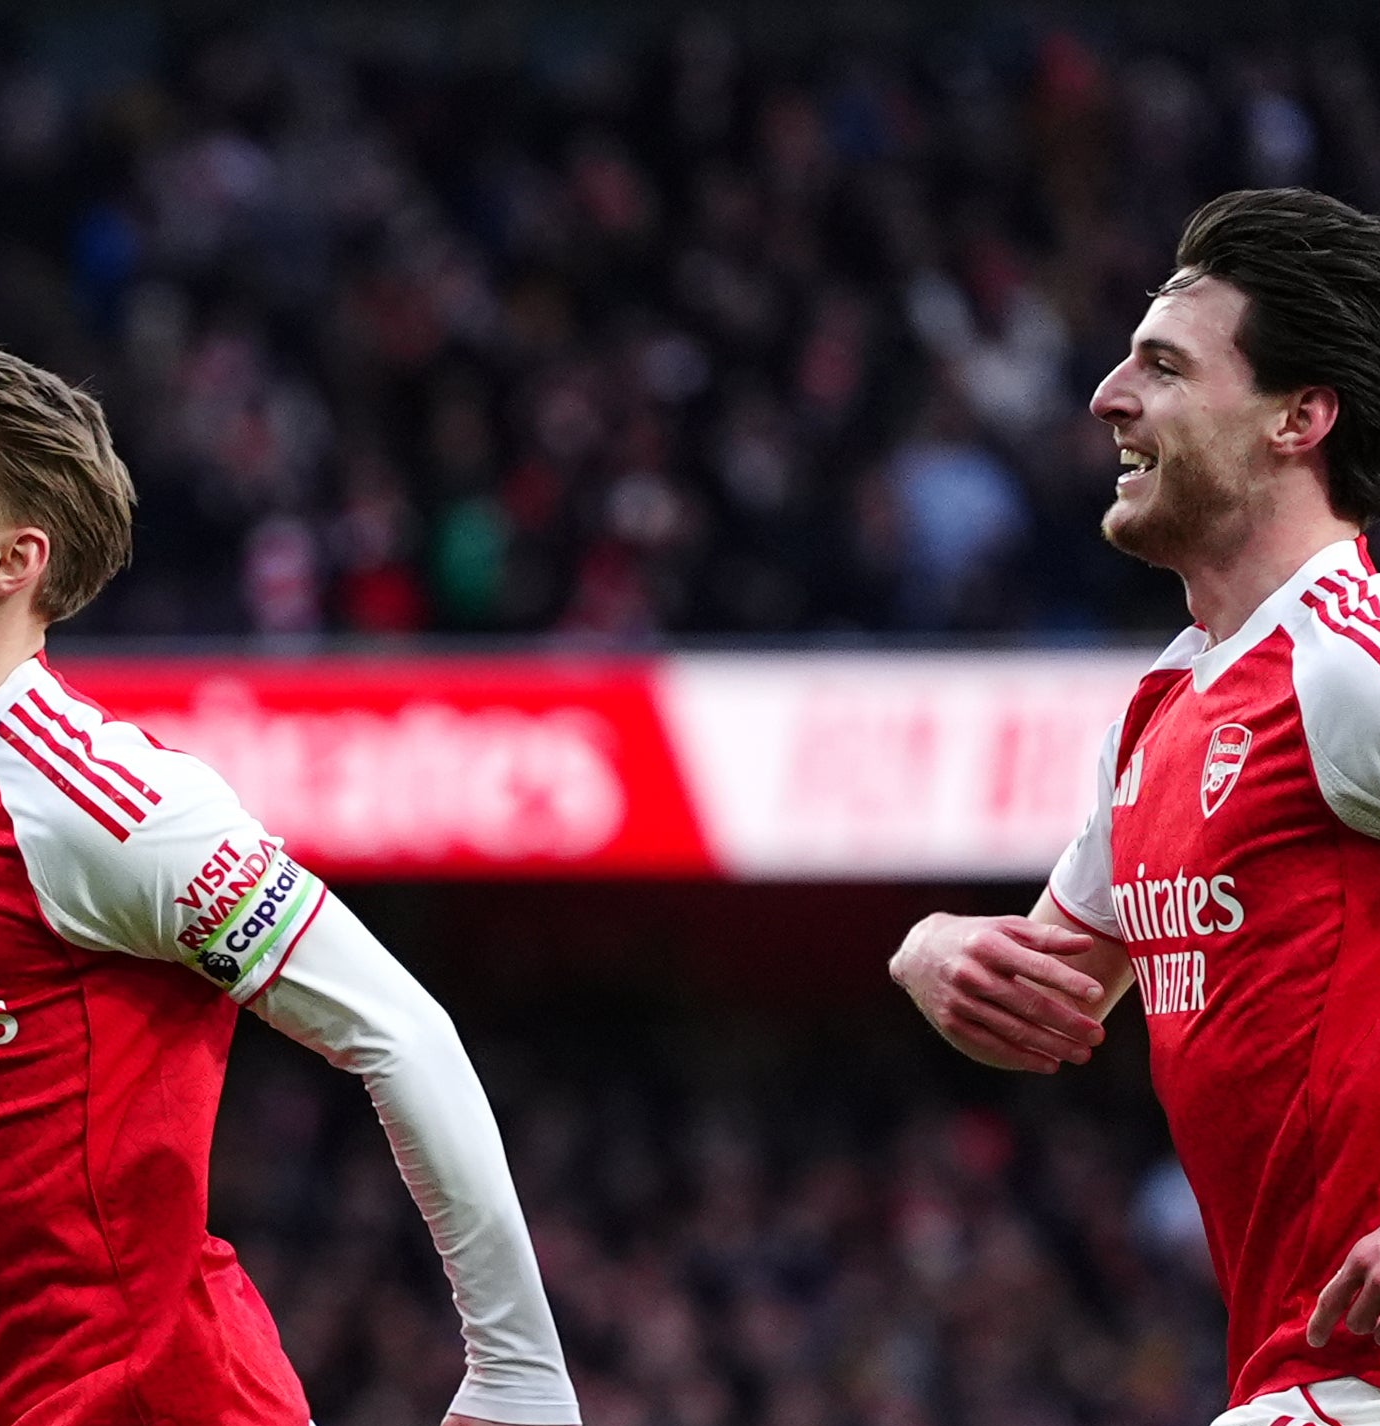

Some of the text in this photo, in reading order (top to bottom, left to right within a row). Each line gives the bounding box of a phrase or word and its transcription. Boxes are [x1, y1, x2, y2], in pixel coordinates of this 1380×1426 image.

[174, 839, 241, 910] VISIT
[177, 839, 277, 950] RWANDA
[1111, 862, 1245, 943] mirates
[1153, 950, 1206, 1014] BETTER
